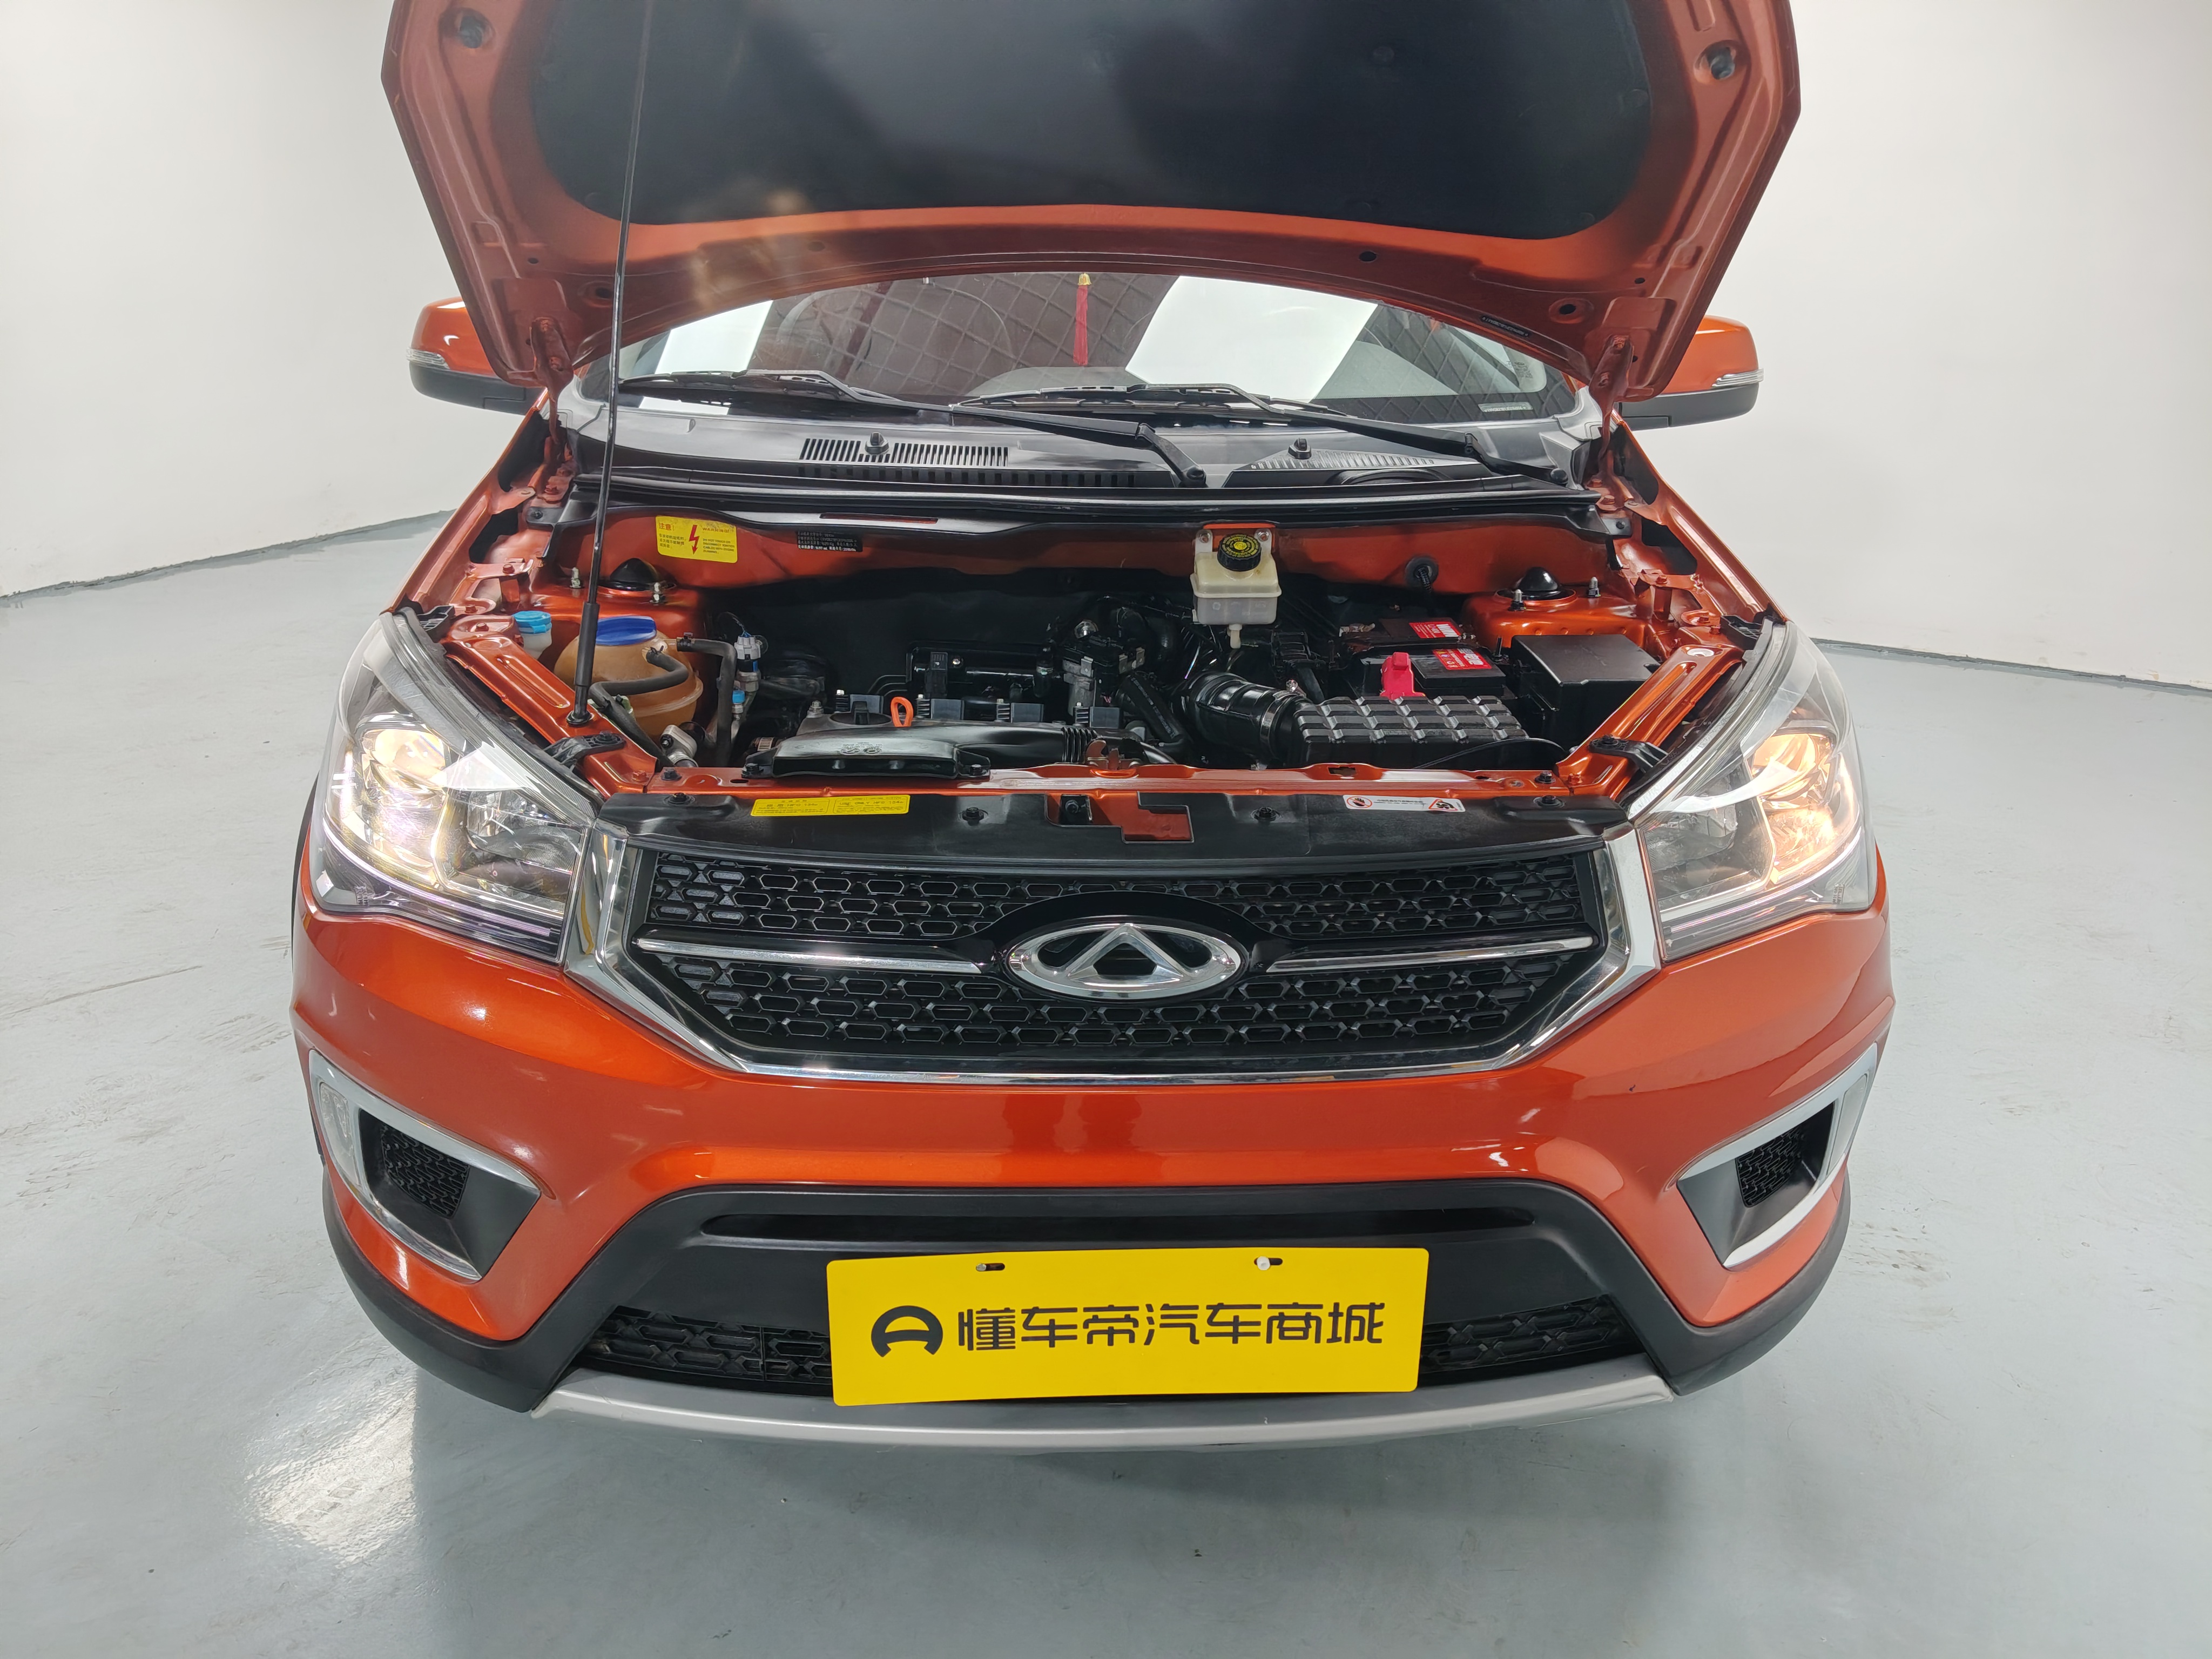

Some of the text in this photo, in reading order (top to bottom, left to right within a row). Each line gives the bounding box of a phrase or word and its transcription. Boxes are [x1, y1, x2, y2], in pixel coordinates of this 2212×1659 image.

[959, 1303, 1385, 1350] 懂车帝汽车商城
